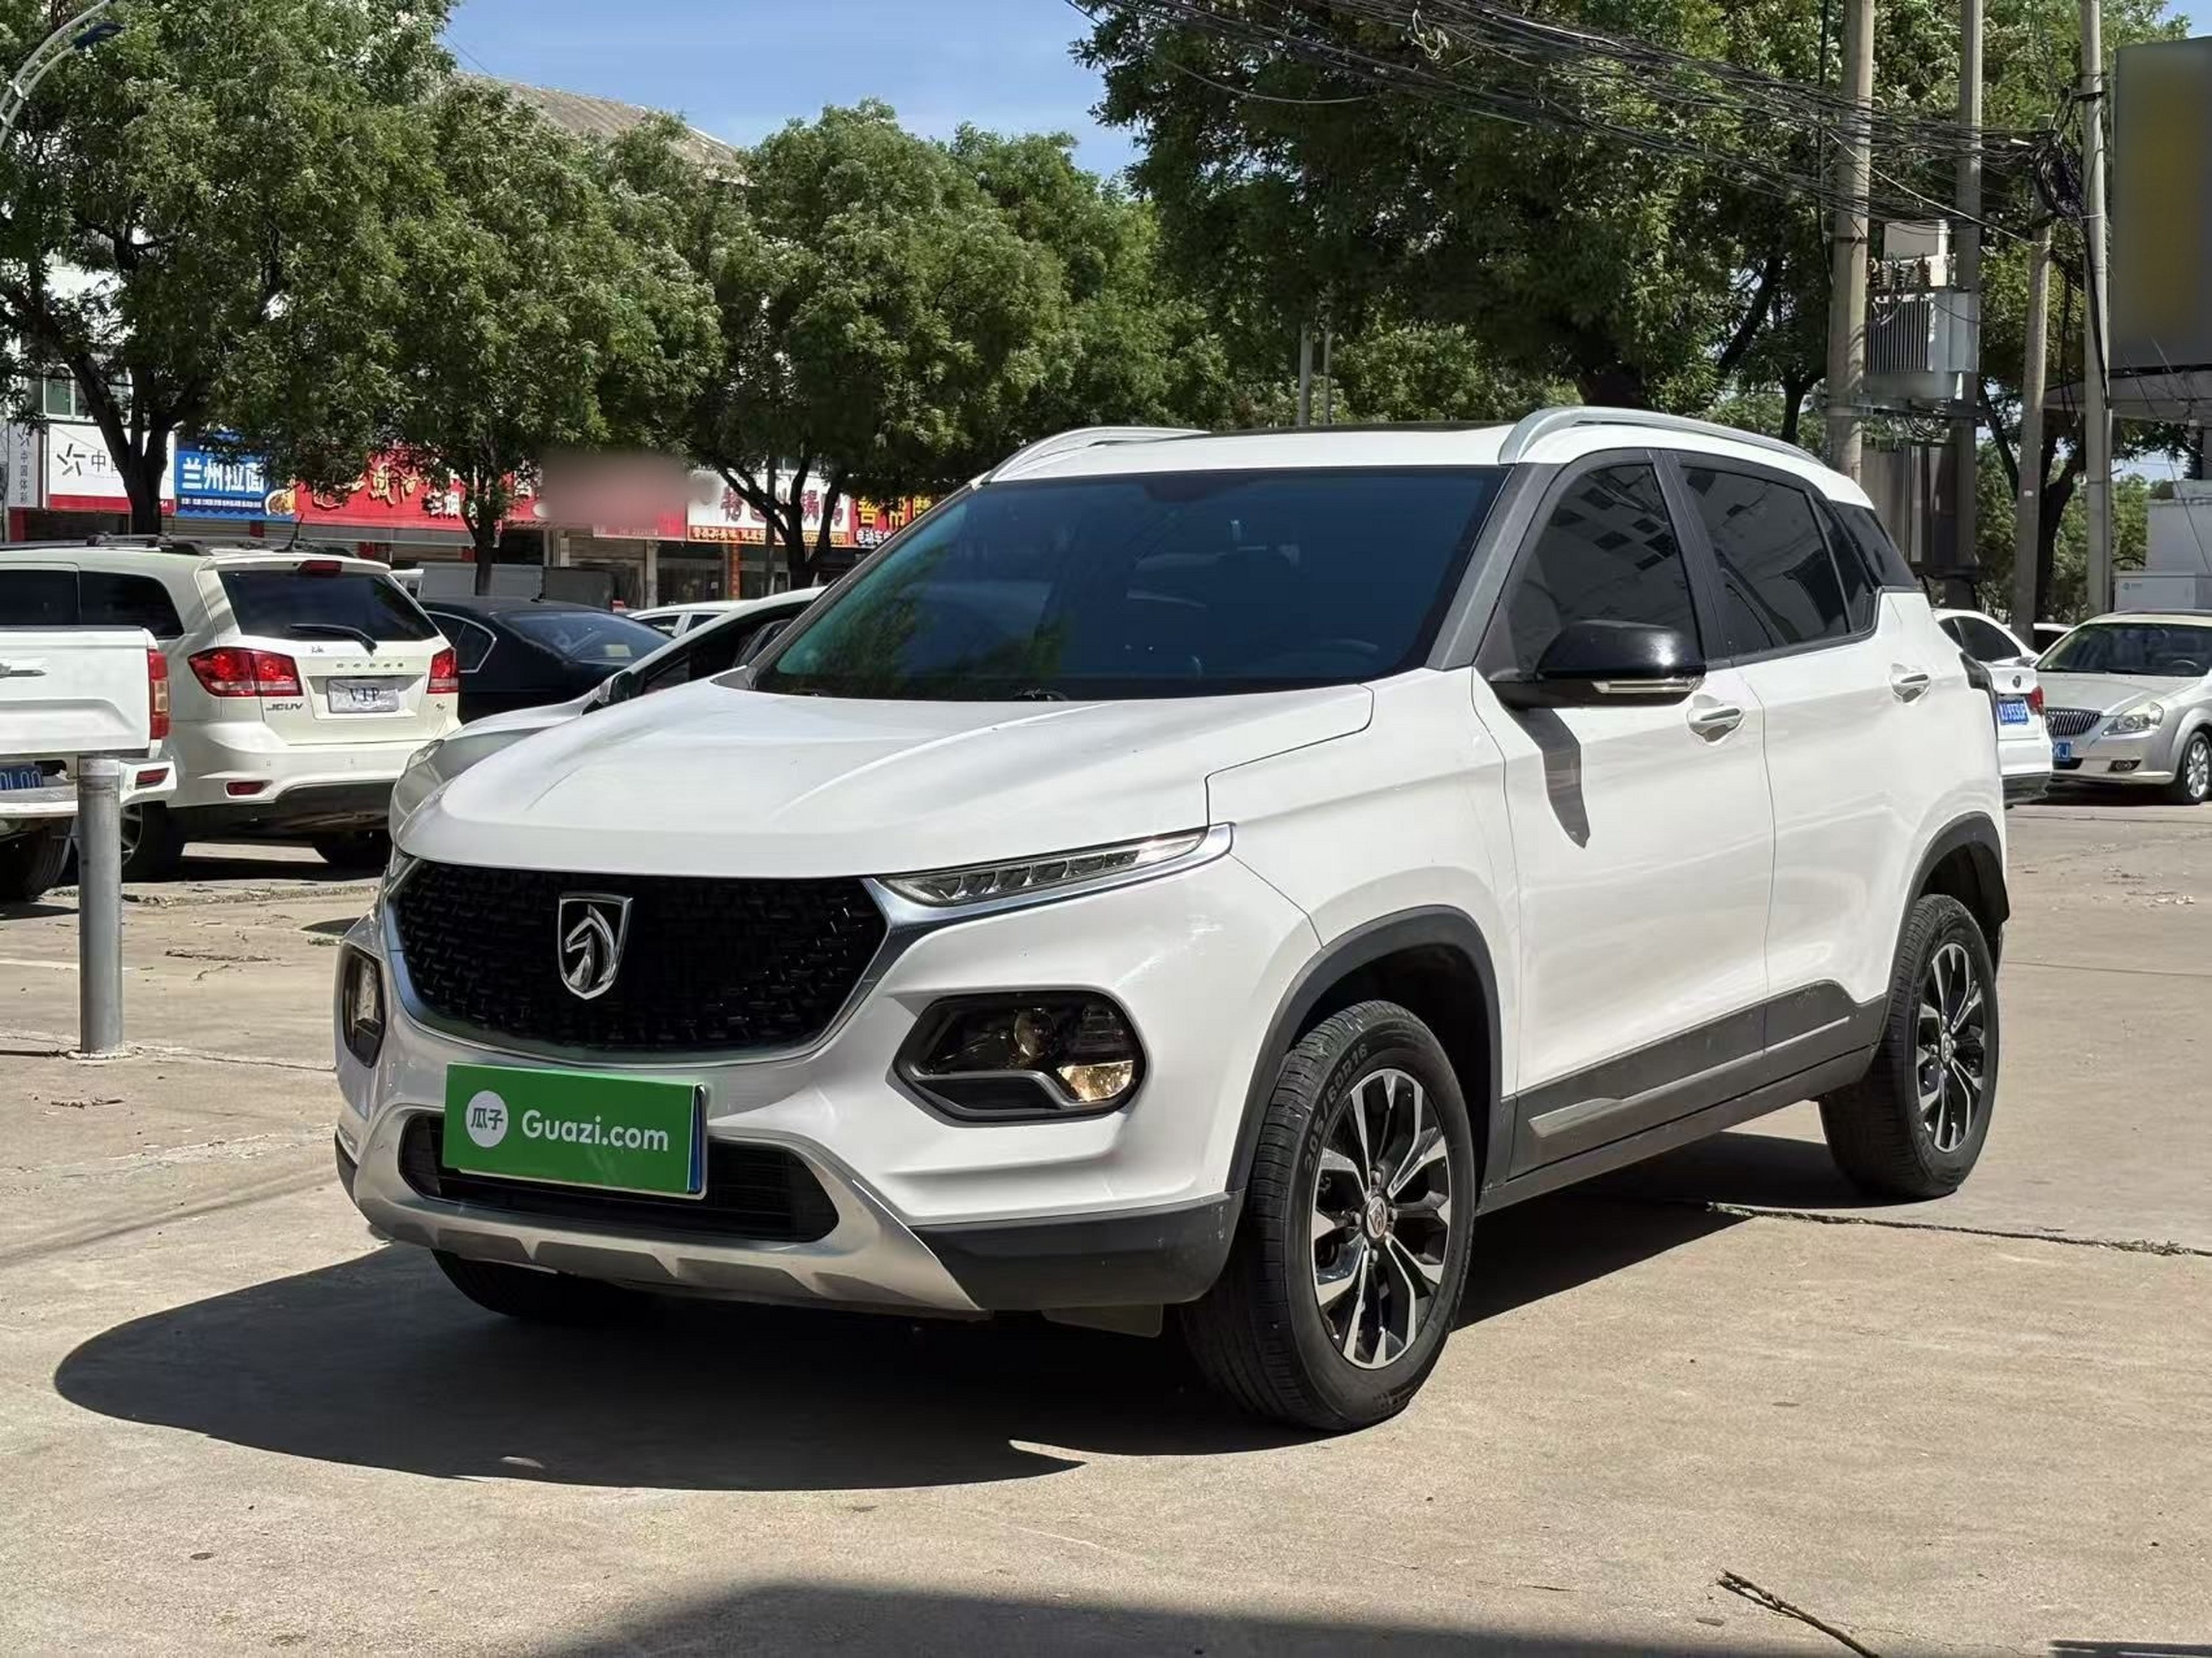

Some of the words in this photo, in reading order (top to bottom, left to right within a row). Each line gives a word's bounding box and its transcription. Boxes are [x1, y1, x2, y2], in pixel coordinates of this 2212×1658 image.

[182, 457, 264, 494] 兰州拉面
[349, 688, 380, 701] VIP
